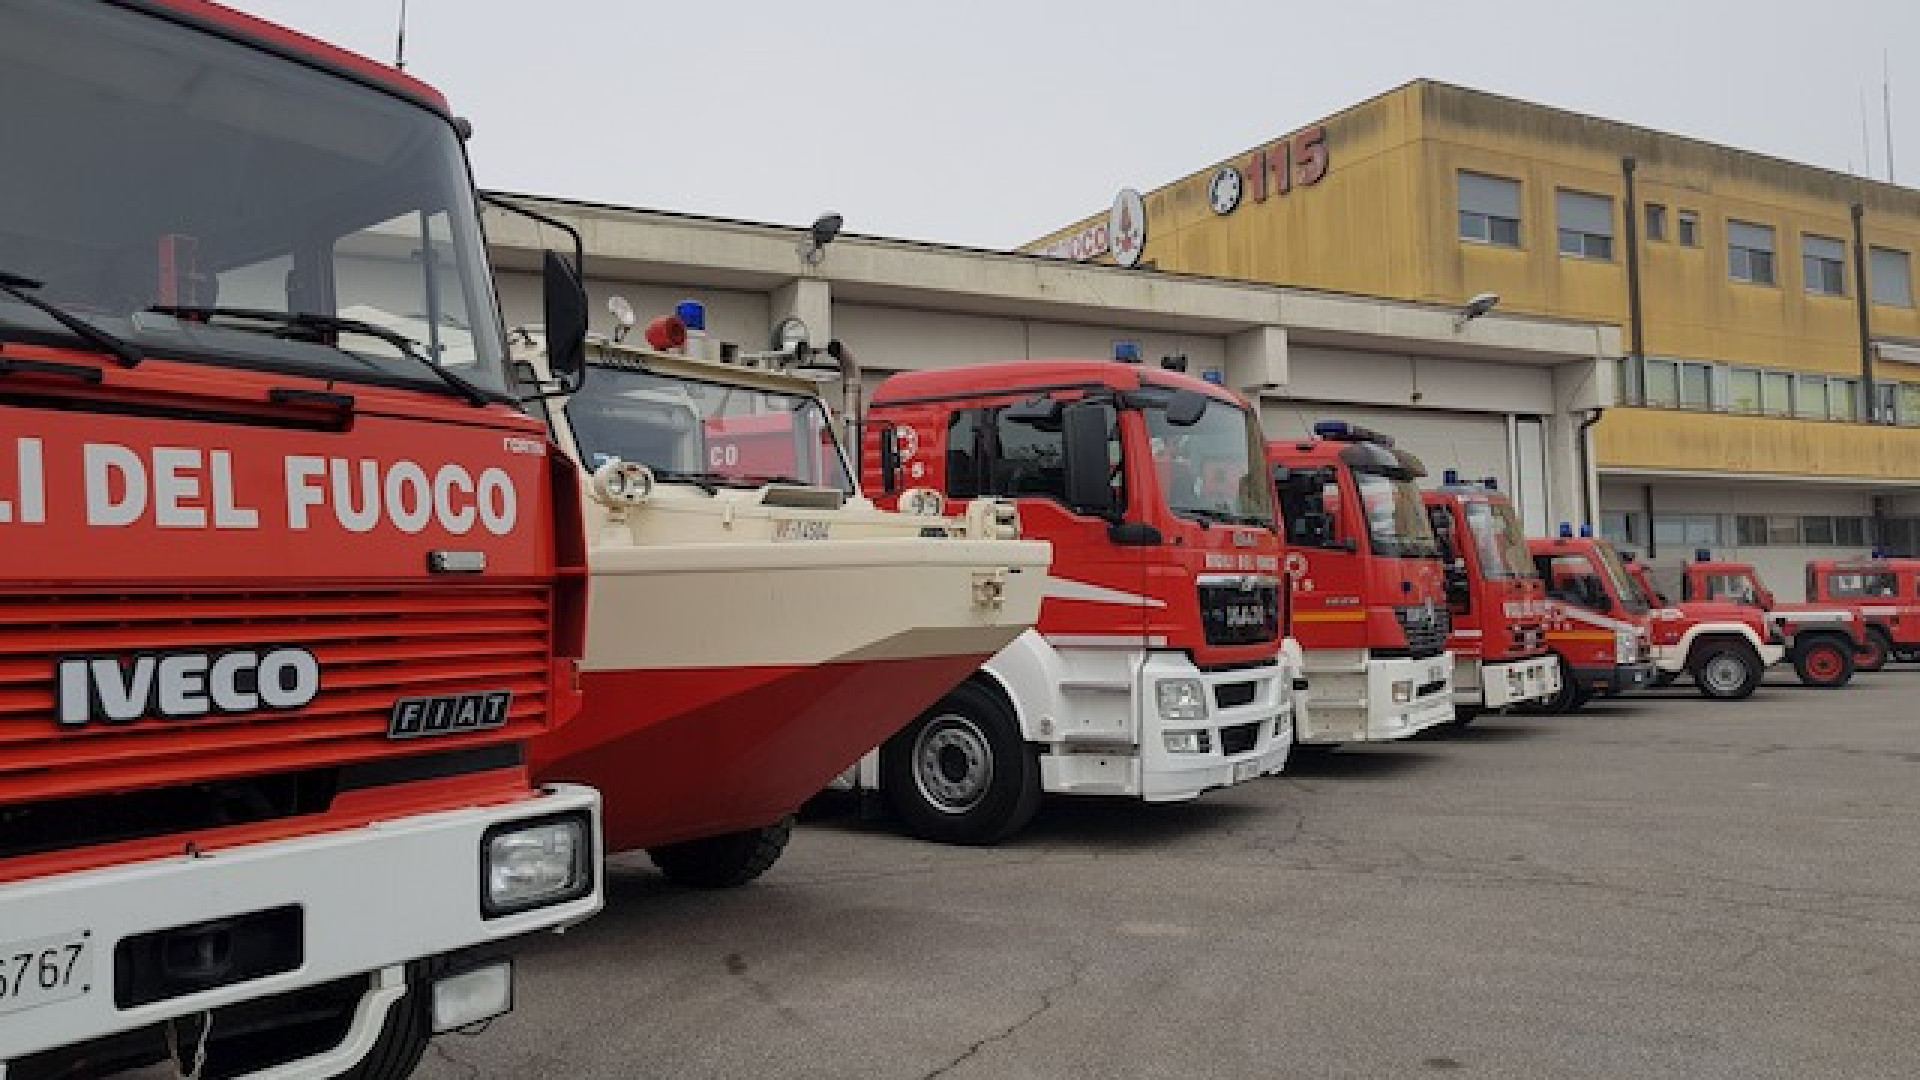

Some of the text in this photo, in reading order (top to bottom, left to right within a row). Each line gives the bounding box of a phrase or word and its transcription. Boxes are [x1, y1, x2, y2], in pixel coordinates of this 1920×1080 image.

[1243, 126, 1329, 204] 115
[83, 442, 259, 529] DEL
[284, 454, 517, 536] FUOCO
[57, 646, 321, 726] IVECO
[394, 691, 511, 736] FIAT
